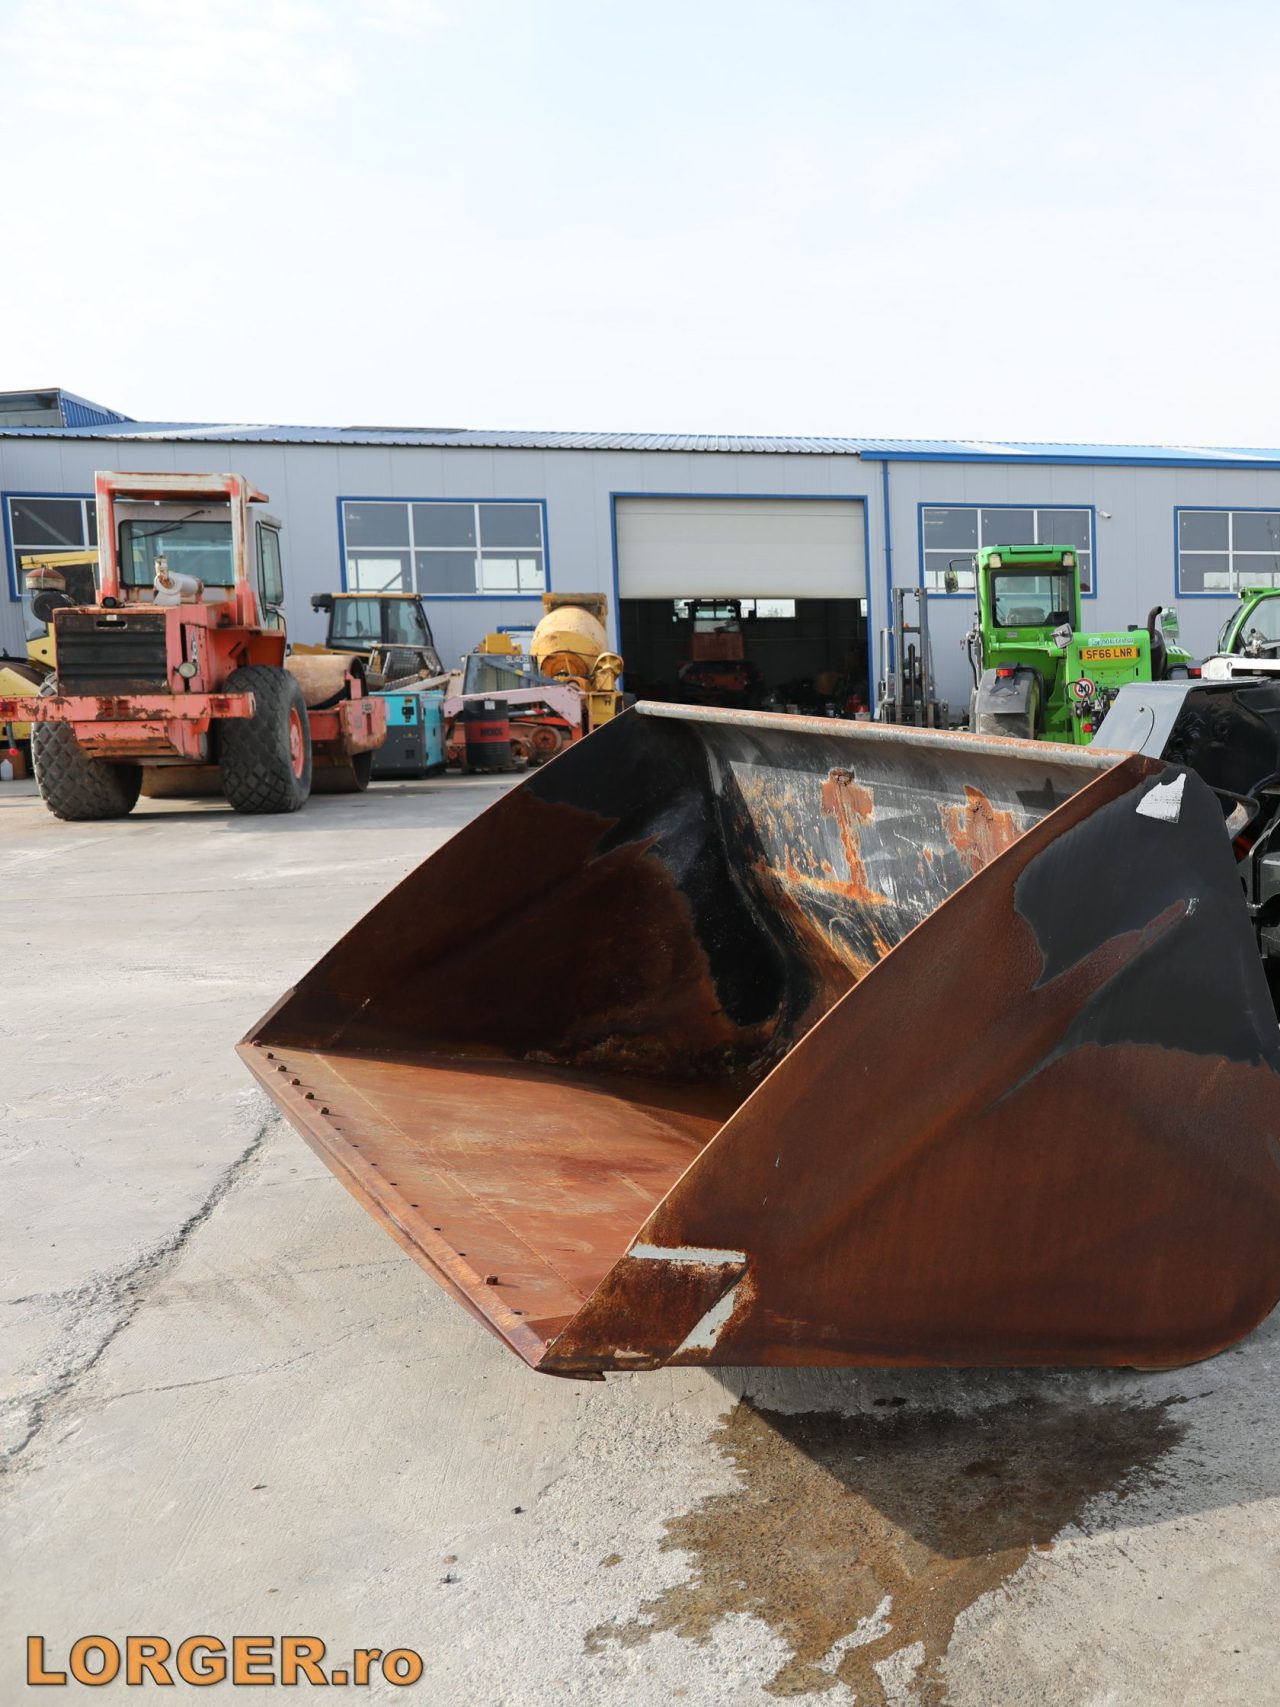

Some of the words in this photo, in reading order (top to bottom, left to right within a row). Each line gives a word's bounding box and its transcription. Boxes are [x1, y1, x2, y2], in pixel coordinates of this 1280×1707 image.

[1086, 649, 1111, 659] SF66
[1114, 648, 1132, 658] LNR
[1078, 684, 1090, 694] 40
